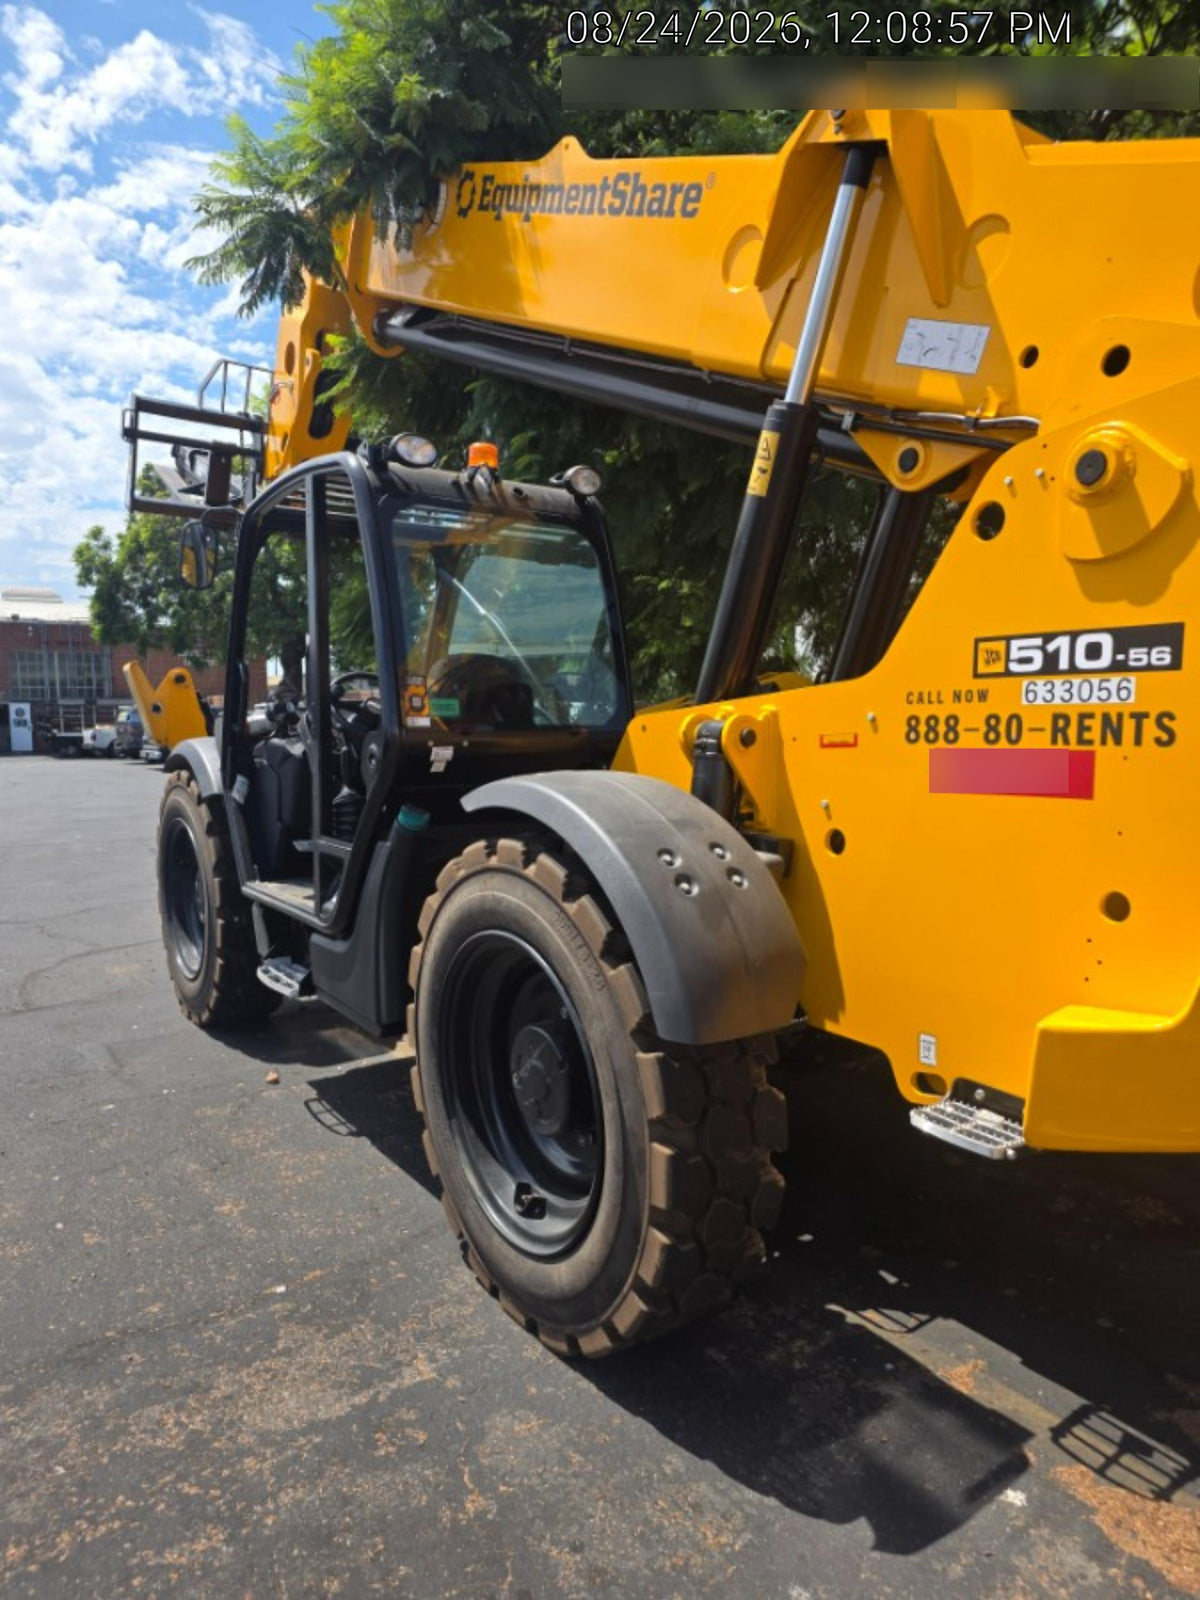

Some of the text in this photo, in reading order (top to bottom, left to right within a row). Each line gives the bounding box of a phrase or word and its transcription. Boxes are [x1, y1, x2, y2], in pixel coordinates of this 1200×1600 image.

[477, 172, 703, 222] EquipmentShare
[1008, 632, 1172, 673] 510-56
[905, 689, 990, 705] CALL NOW
[1024, 678, 1132, 703] 633056
[904, 711, 1178, 747] 888-80-RENTS
